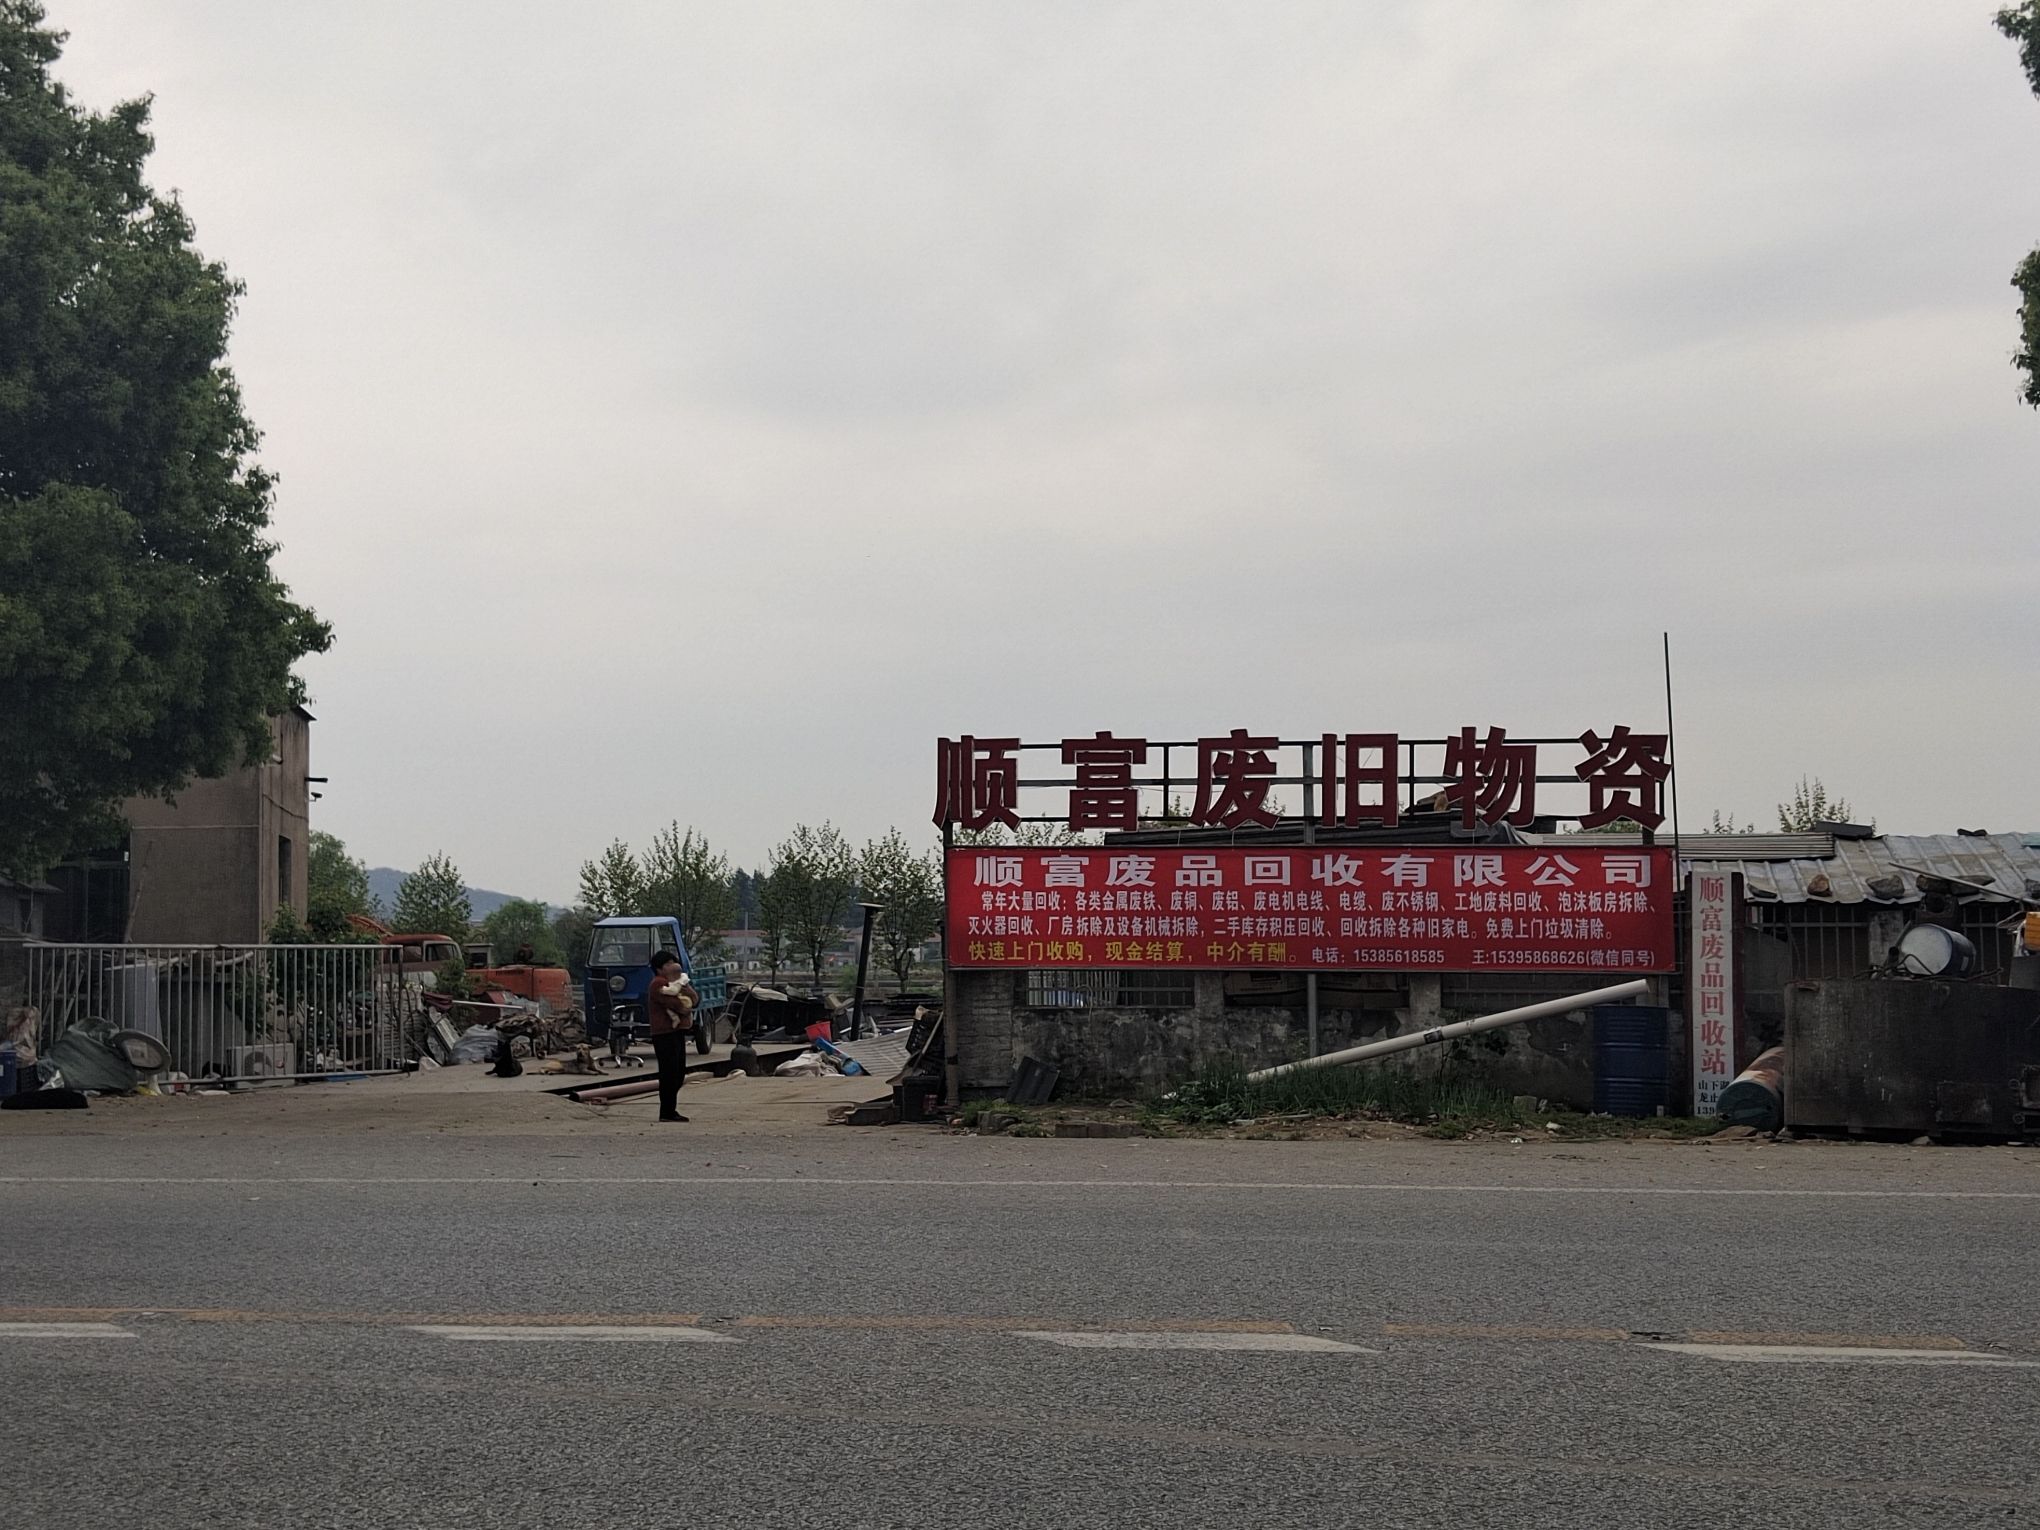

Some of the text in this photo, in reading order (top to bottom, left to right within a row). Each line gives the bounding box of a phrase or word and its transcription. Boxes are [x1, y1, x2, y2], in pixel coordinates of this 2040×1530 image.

[932, 724, 1671, 832] 顺富废旧物资
[973, 854, 1652, 888] 顺富废品回收有限公司
[1699, 876, 1727, 1076] 顺富废品回收站
